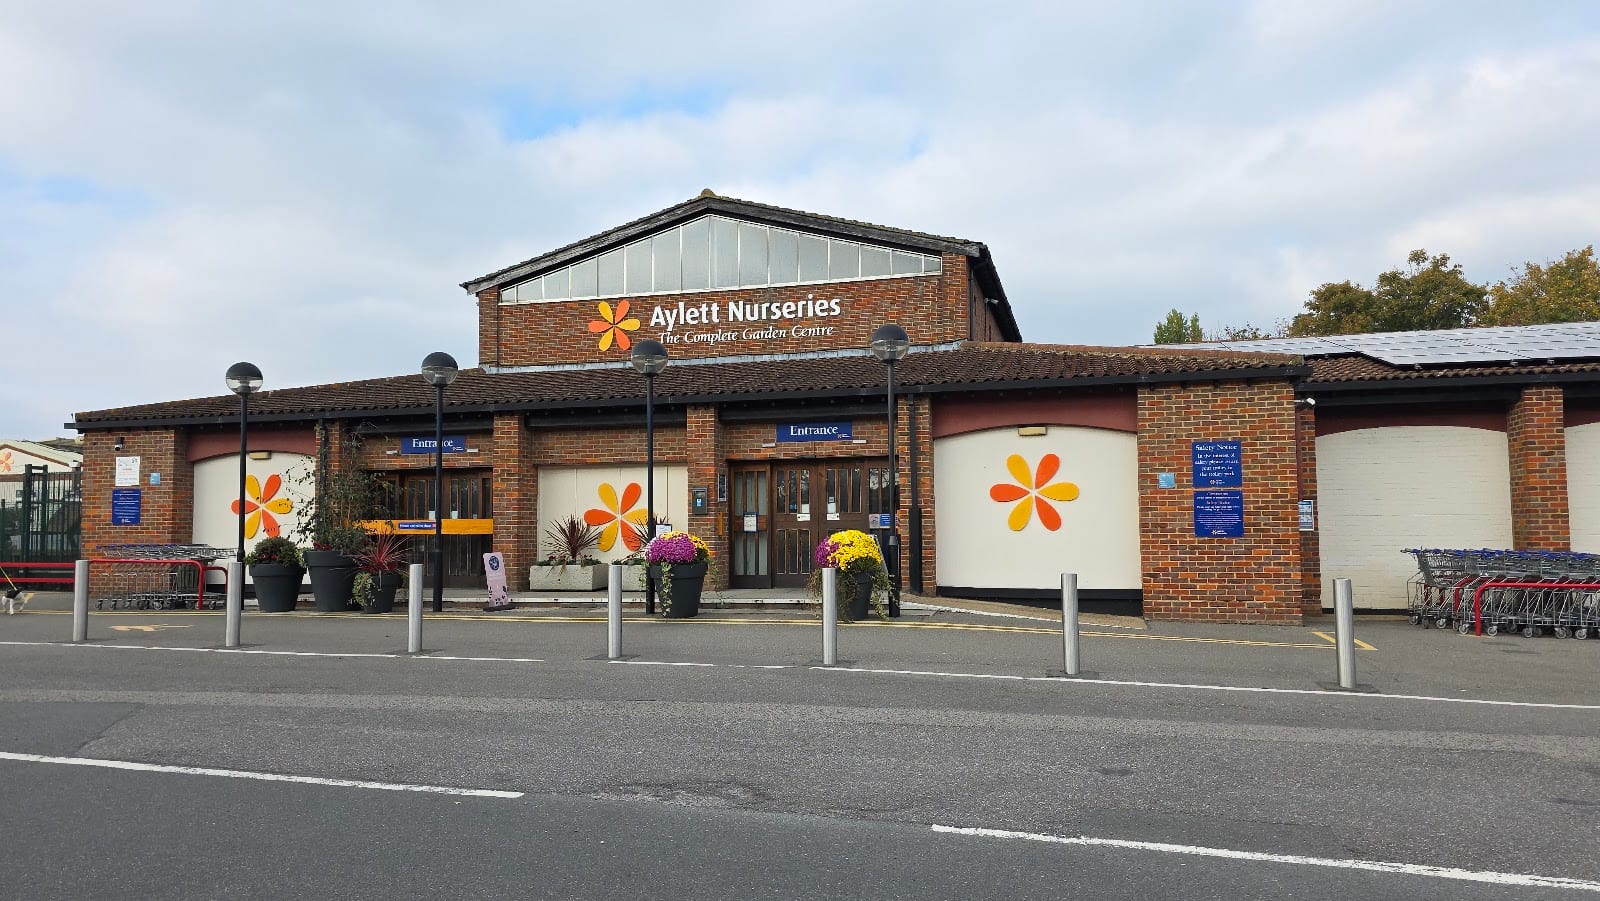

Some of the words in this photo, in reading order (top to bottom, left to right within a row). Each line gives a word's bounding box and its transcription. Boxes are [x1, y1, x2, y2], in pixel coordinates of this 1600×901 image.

[650, 302, 720, 331] Aylett
[728, 294, 841, 322] Nurseries
[658, 331, 680, 344] The
[684, 329, 738, 345] Complete
[742, 326, 787, 341] Garden
[791, 325, 834, 338] Centre
[790, 425, 839, 436] Entrance
[412, 438, 454, 448] Entrace
